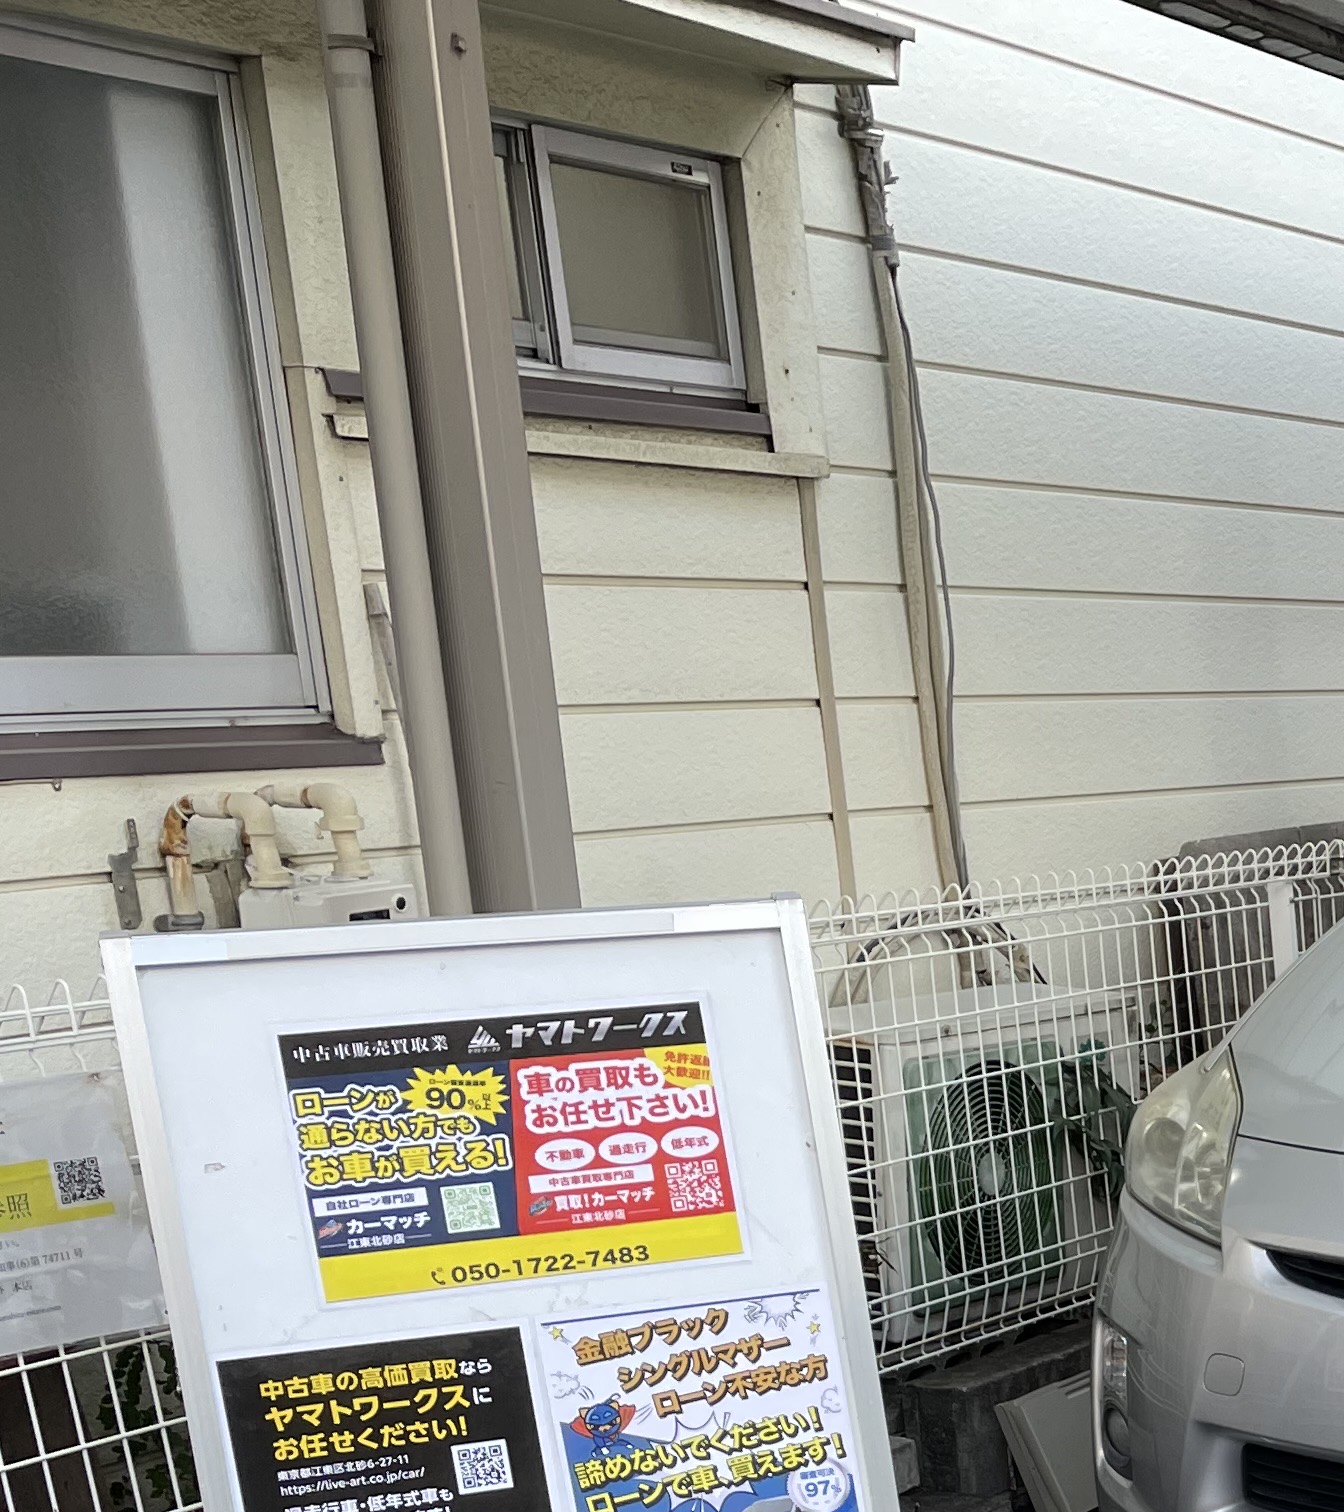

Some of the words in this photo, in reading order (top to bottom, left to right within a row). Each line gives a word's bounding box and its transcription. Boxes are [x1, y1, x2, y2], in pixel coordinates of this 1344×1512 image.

[293, 1034, 449, 1063] 中古車販売買取業
[506, 1010, 689, 1049] ヤマトワークス
[524, 1063, 659, 1098] 車の買取も
[294, 1088, 397, 1117] ローンが
[530, 1089, 710, 1129] お任せ下さい!
[299, 1112, 476, 1150] 通らない方でも
[608, 1141, 647, 1156] 過走行
[671, 1135, 710, 1151] 低年式
[306, 1137, 509, 1186] お車が買える!
[545, 1147, 585, 1162] 不動車
[0, 1191, 33, 1220] 照
[325, 1192, 415, 1211] 自社ローン専門店
[571, 1208, 626, 1225] 江東北砂店
[346, 1211, 431, 1235] カーマッチ
[347, 1233, 405, 1250] 江東北砂店
[451, 1244, 650, 1284] 050-1722-7483
[571, 1306, 729, 1367] 金融ブラック
[258, 1357, 493, 1402] 中古車の高価買取なら
[616, 1332, 791, 1393] シングルマザー
[652, 1353, 829, 1418] ローン不安な方
[264, 1384, 493, 1433] ヤマトワークスに
[271, 1415, 468, 1463] お任せください!
[572, 1405, 824, 1490] 諦めないでください!
[280, 1466, 427, 1498] https://live-art.co.jp/car/
[803, 1480, 842, 1498] 97%
